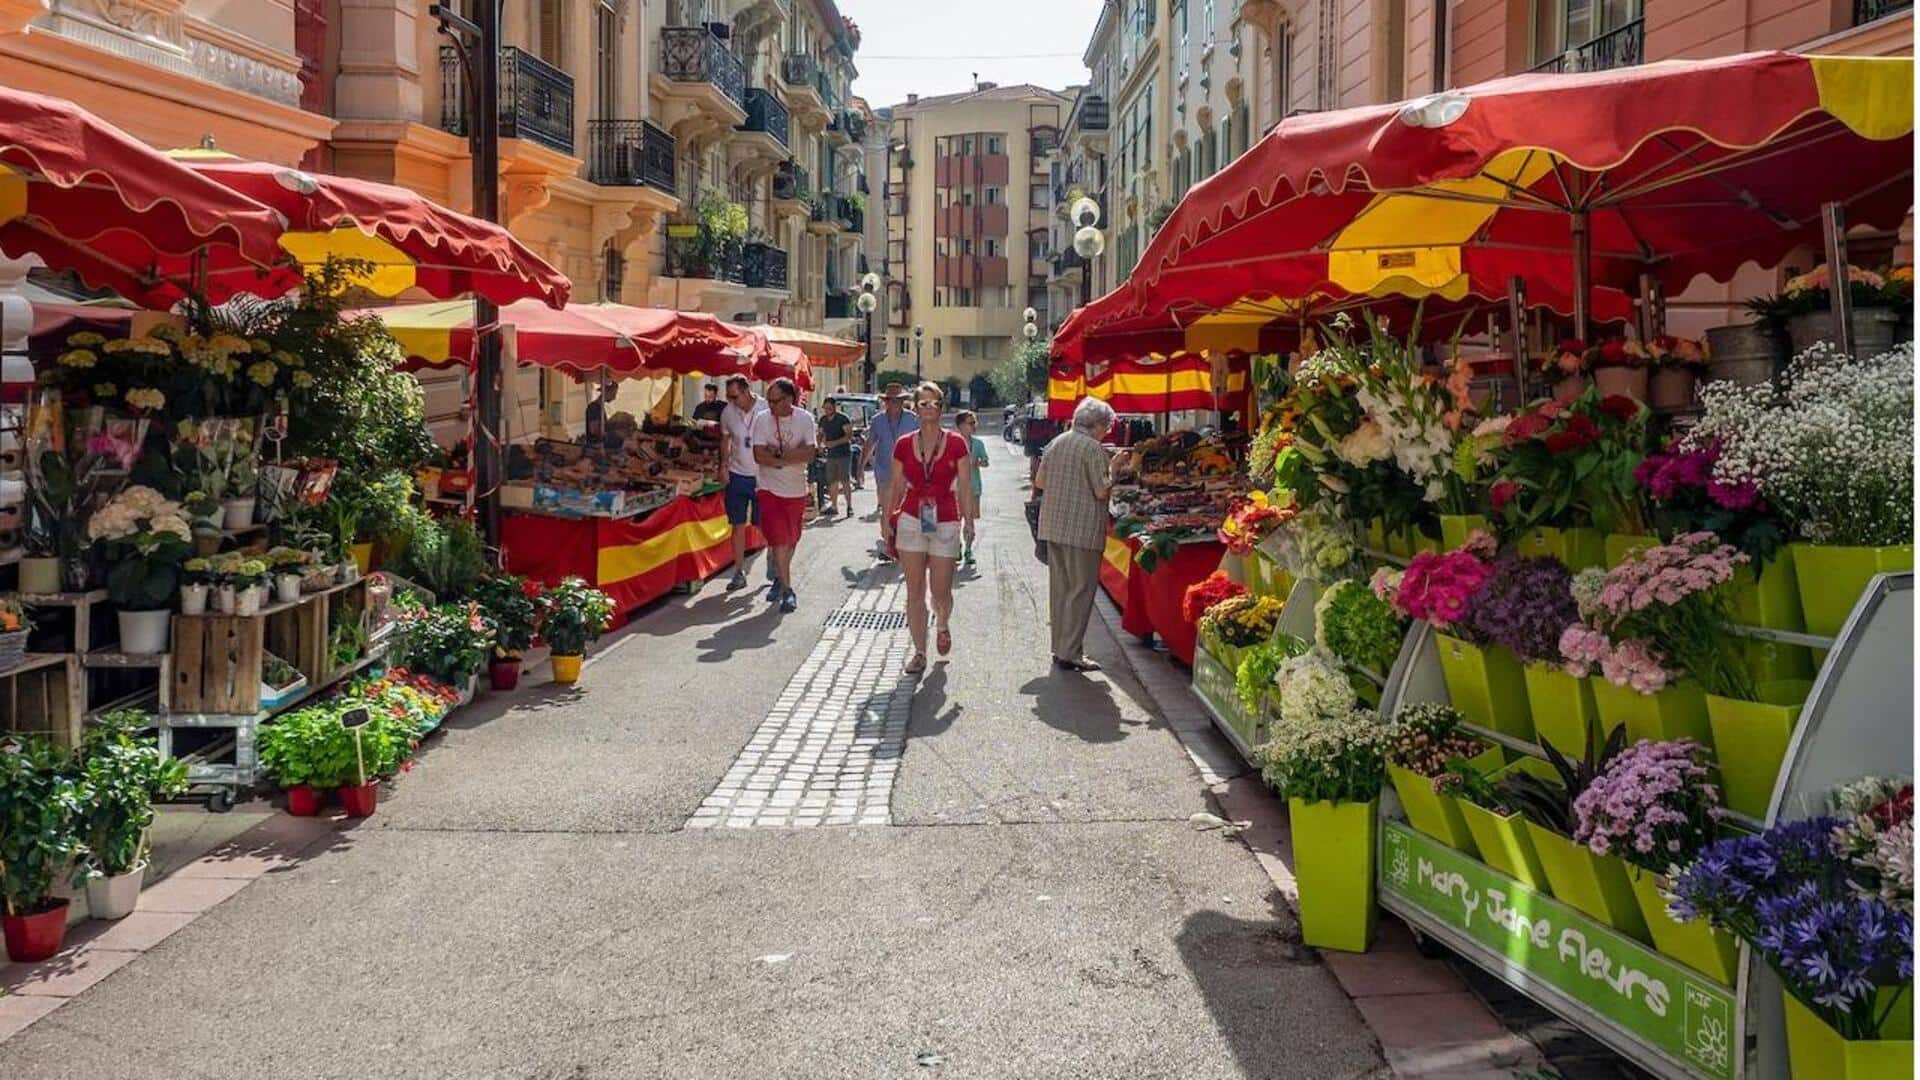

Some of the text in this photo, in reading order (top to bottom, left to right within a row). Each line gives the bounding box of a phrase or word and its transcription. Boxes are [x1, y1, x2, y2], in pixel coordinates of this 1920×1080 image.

[1417, 856, 1670, 1018] Mary Jane Fleurs
